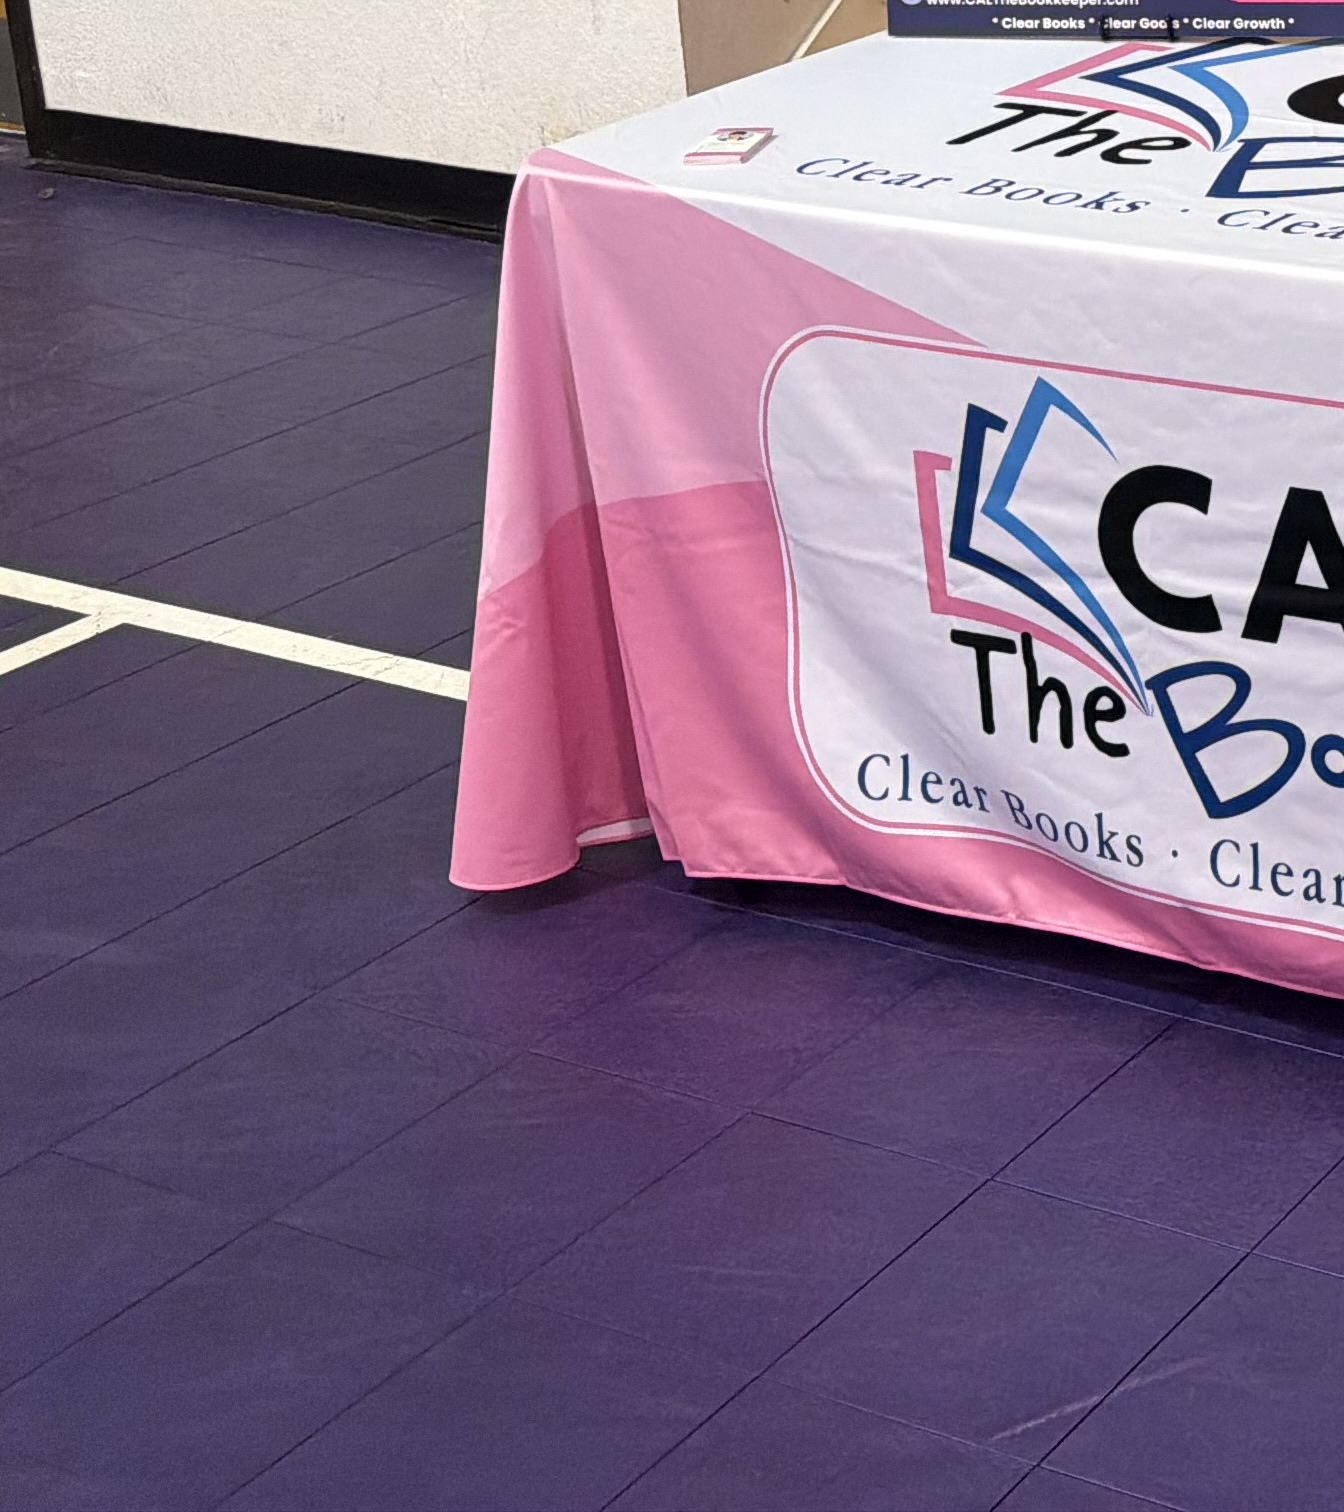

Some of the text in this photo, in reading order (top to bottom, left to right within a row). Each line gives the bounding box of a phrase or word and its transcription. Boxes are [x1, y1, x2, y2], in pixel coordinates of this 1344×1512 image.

[1002, 18, 1041, 30] Clear
[1043, 18, 1086, 30] Books
[1139, 18, 1180, 30] Goas
[1193, 18, 1231, 30] Clear
[1233, 17, 1286, 30] Growth
[946, 102, 1191, 165] The
[796, 156, 1151, 214] Clear Books
[950, 629, 1130, 758] The
[857, 753, 990, 814] Clear
[1000, 789, 1144, 868] Books
